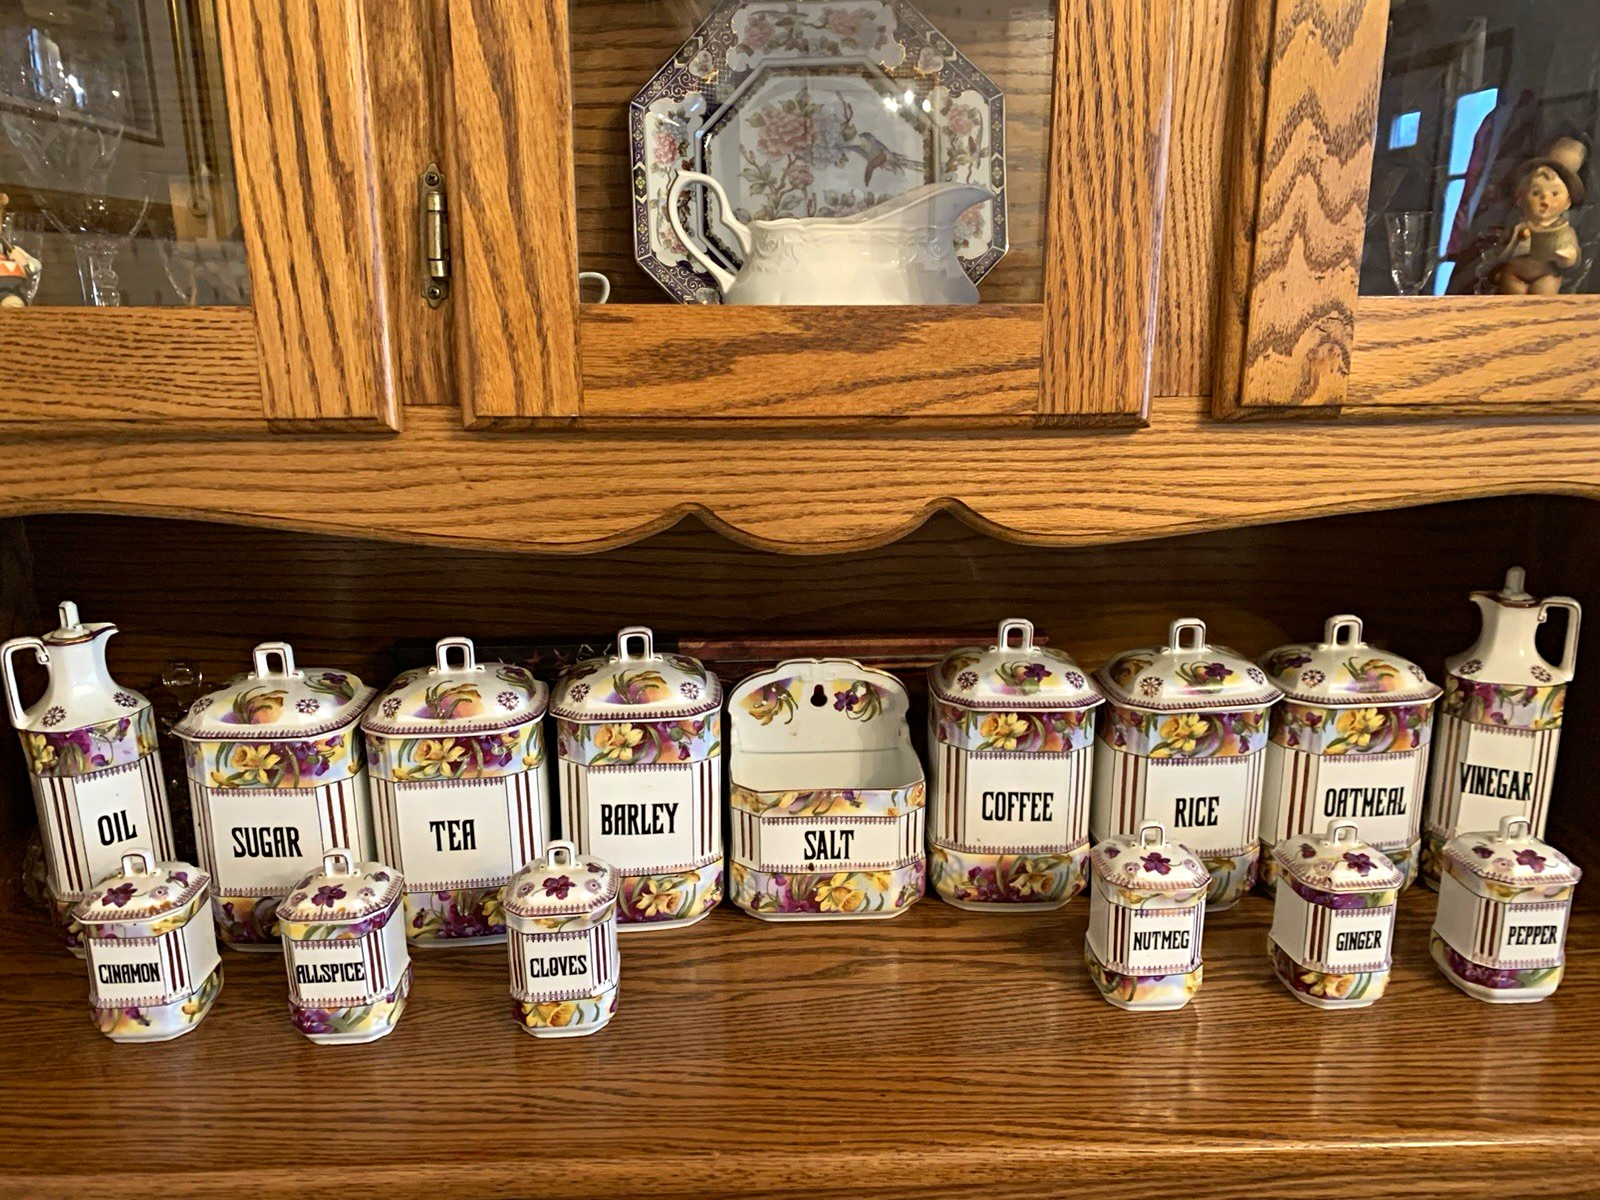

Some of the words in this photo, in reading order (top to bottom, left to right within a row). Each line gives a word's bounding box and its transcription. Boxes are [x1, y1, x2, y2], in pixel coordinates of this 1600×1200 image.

[1459, 761, 1533, 801] VINEGAR
[981, 791, 1054, 822] COFFEE
[1174, 796, 1220, 828] RICE
[1324, 786, 1406, 818] OATMEAL
[97, 809, 138, 846] OIL
[429, 819, 477, 851] TEA
[600, 802, 679, 836] BARLEY
[231, 826, 303, 858] SUGAR
[804, 829, 855, 861] SALT
[1133, 930, 1190, 951] NUTMEG
[1335, 930, 1382, 952] GINGER
[1507, 925, 1558, 946] PEPPER
[98, 962, 161, 985] CINAMON
[295, 960, 366, 985] ALLSPICE
[529, 954, 588, 978] CLOVES
